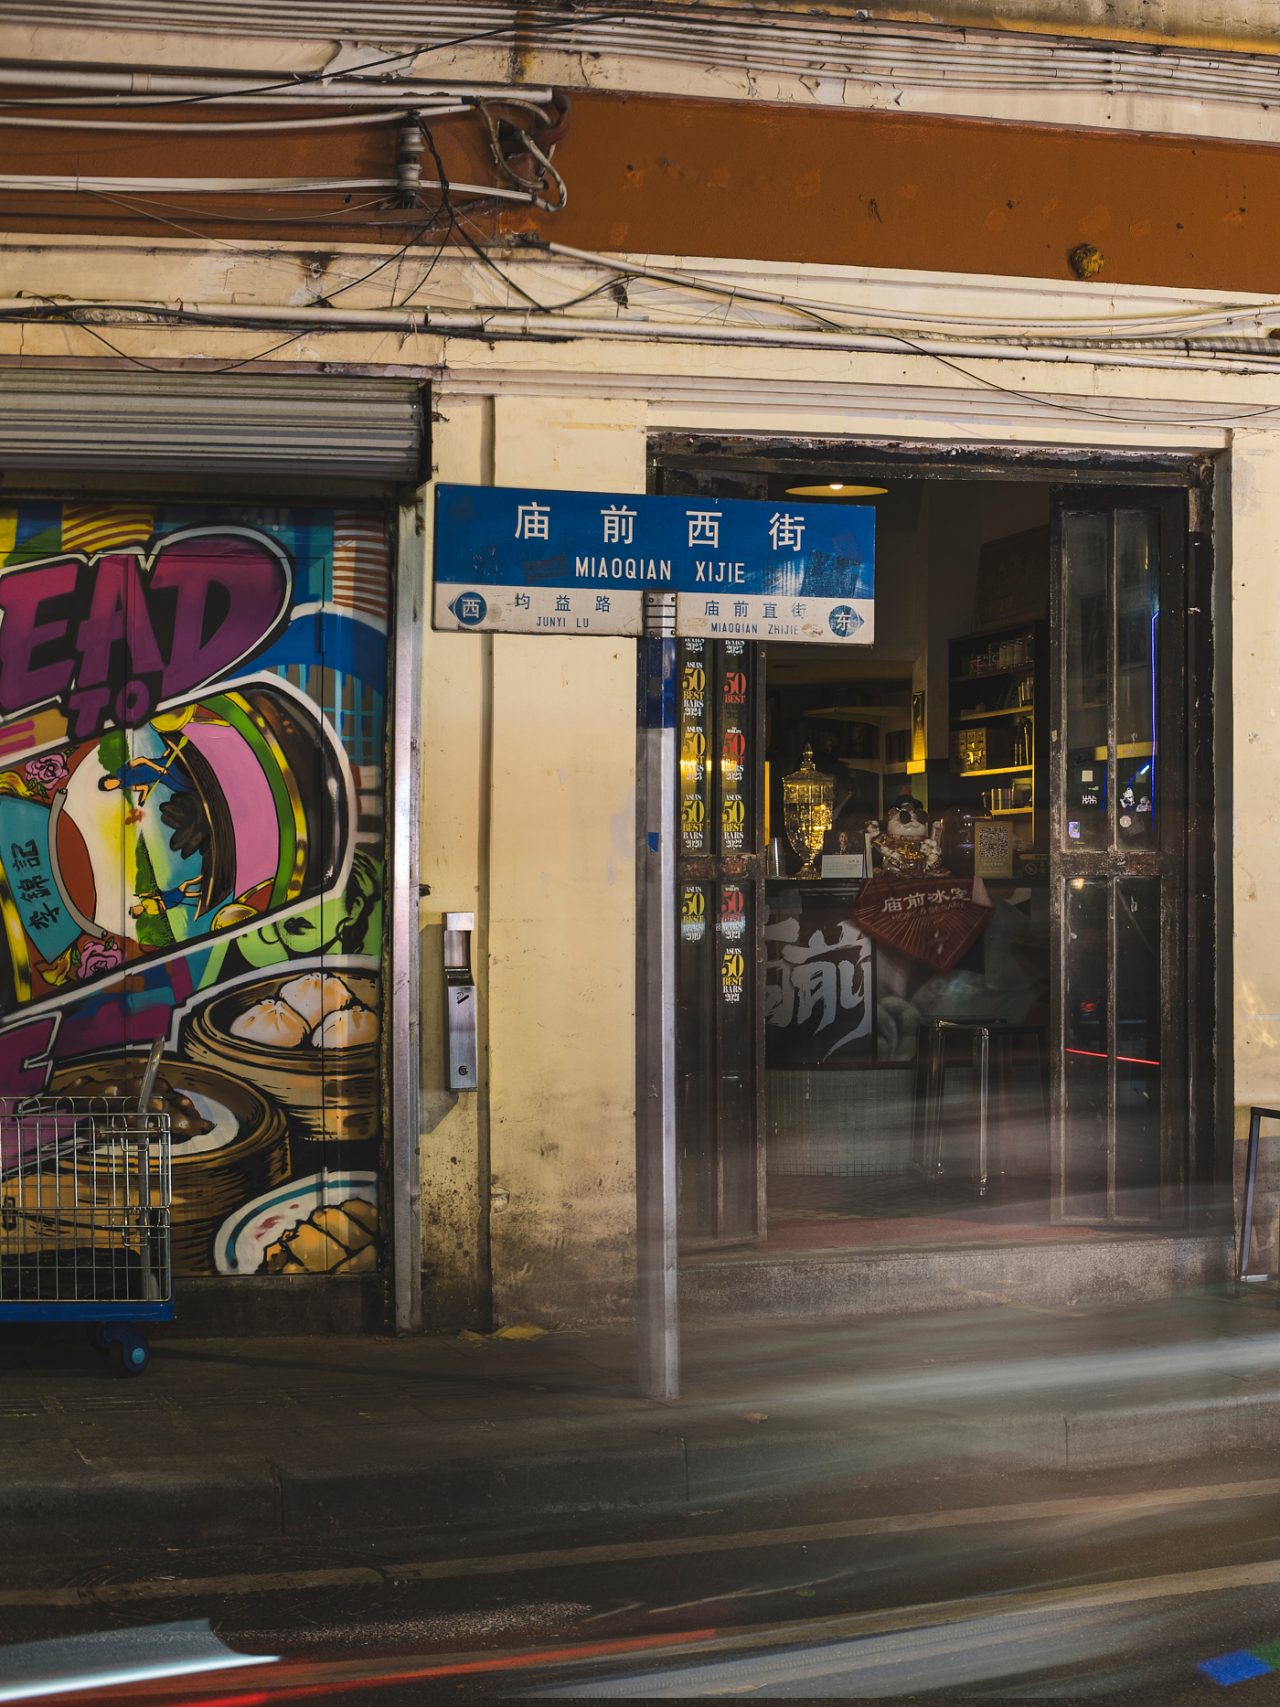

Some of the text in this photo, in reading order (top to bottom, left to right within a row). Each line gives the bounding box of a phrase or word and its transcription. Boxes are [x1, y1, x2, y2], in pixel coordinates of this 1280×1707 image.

[515, 501, 806, 551] 庙前西街
[575, 556, 746, 584] MIAOQIAN XIJIE
[461, 600, 482, 619] 西
[514, 592, 612, 613] 均益路
[704, 600, 808, 619] 庙前直街
[536, 616, 590, 629] JUNYI LU
[711, 622, 799, 636] MIAOQIAN ZHIJIE
[835, 610, 851, 630] 东
[682, 668, 706, 692] 50
[723, 672, 747, 695] 50
[683, 692, 704, 700] BEST
[724, 695, 745, 703] BEST
[682, 733, 706, 756] 50
[723, 733, 746, 757] 50
[681, 800, 705, 823] 50
[721, 800, 745, 823] 50
[682, 823, 703, 832] BEST
[722, 823, 744, 832] BEST
[681, 892, 705, 915] 50
[722, 891, 744, 913] 50
[721, 954, 745, 977] 50
[722, 977, 743, 986] BEST
